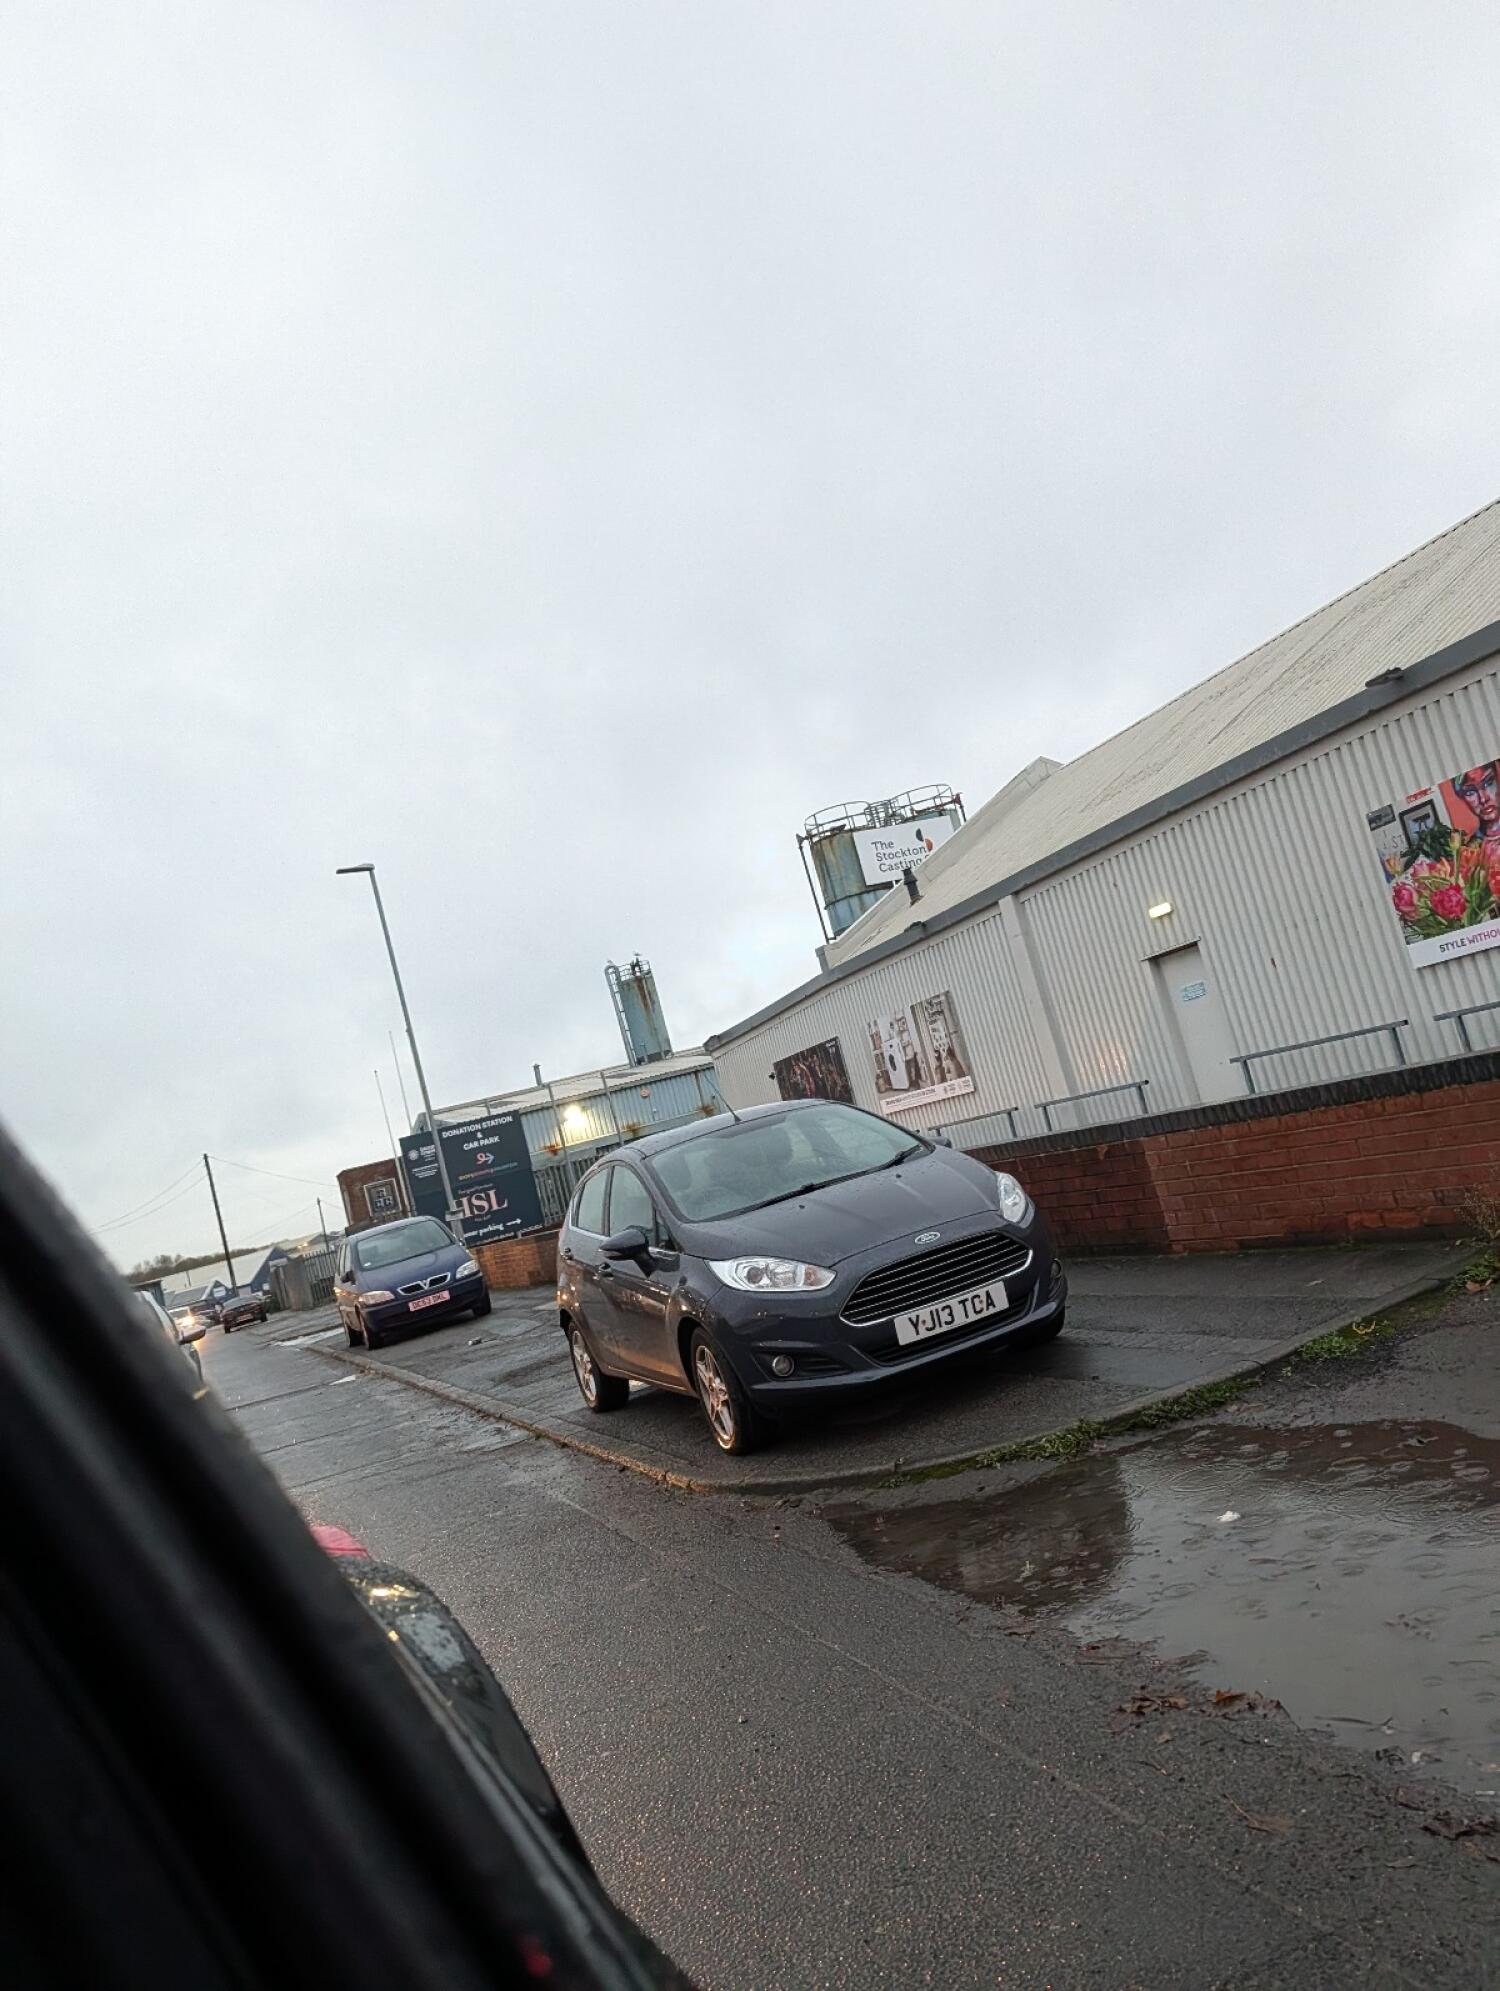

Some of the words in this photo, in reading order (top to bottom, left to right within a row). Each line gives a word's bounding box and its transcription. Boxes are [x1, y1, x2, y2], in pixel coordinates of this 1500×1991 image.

[871, 840, 895, 852] The
[875, 845, 927, 862] Stockton
[1439, 938, 1467, 953] STYLE
[1466, 927, 1500, 947] WITHO
[441, 1122, 481, 1139] DONATION
[482, 1114, 513, 1130] STATION
[463, 1140, 479, 1151] CAR
[479, 1135, 500, 1148] PARK
[908, 1304, 956, 1336] YJ13
[958, 1290, 996, 1319] TCA
